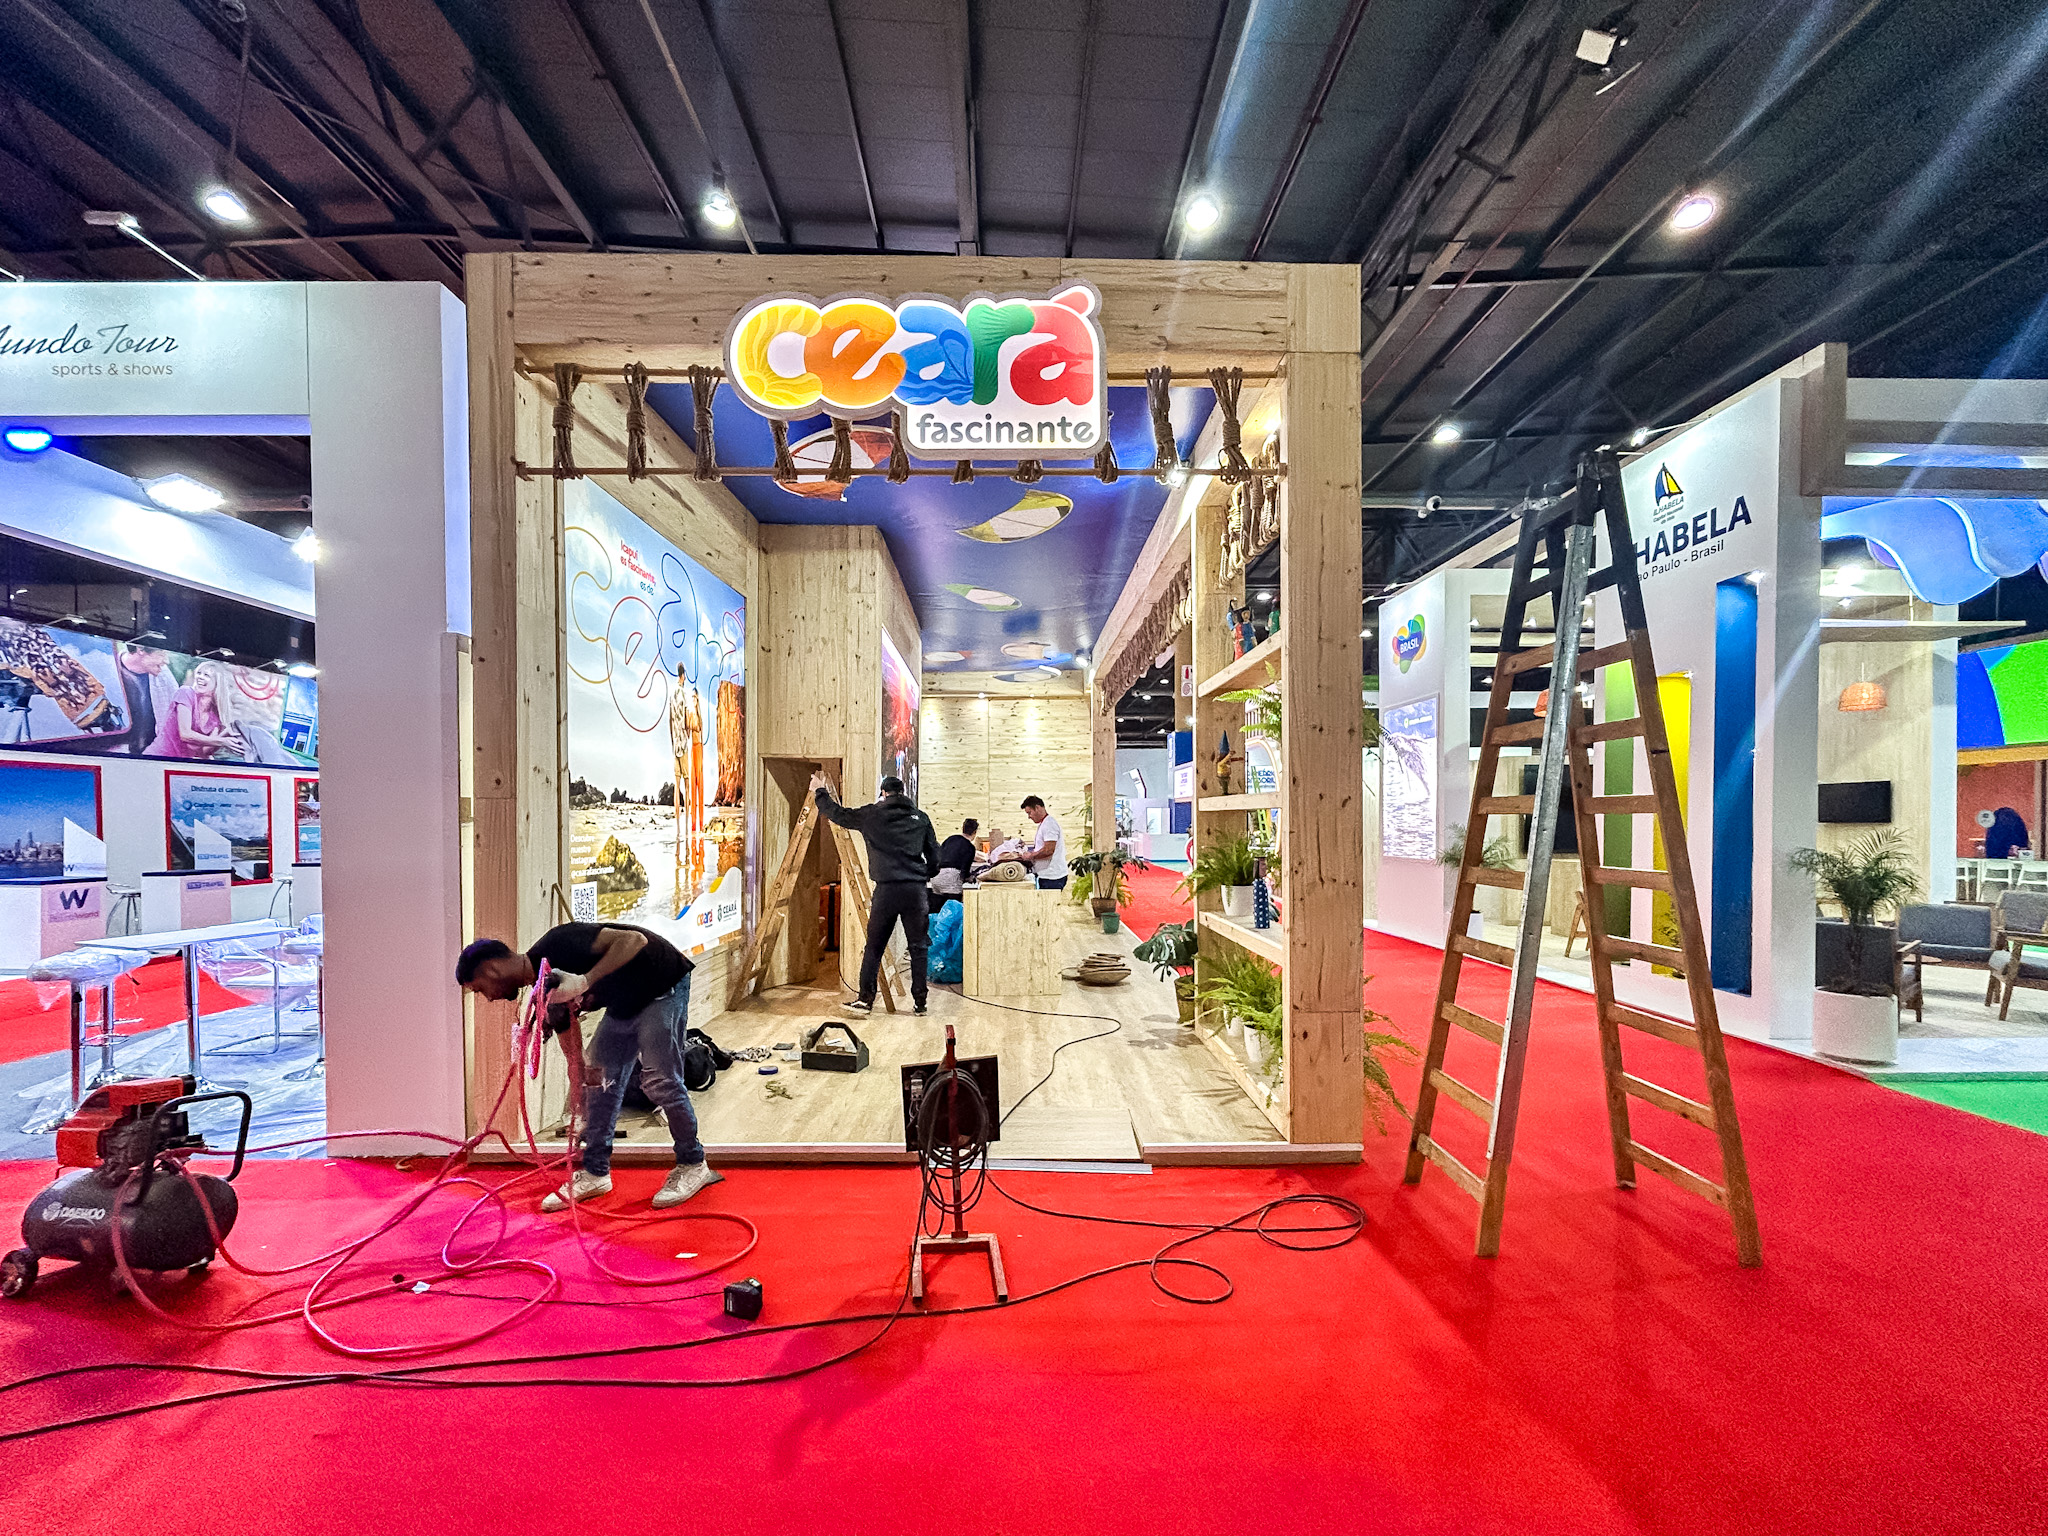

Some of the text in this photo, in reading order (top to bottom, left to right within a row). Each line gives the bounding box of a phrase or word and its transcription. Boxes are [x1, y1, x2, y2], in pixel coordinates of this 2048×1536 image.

[0, 323, 179, 355] undo Tour
[737, 291, 1094, 406] ceará
[52, 362, 173, 376] sports & shows
[916, 413, 1094, 444] fascinante
[1633, 495, 1753, 566] HABELA
[1652, 559, 1681, 577] Paulo
[1691, 539, 1724, 562] Brasil
[1400, 637, 1420, 654] BRASIL
[60, 1207, 106, 1220] DAEWOO
